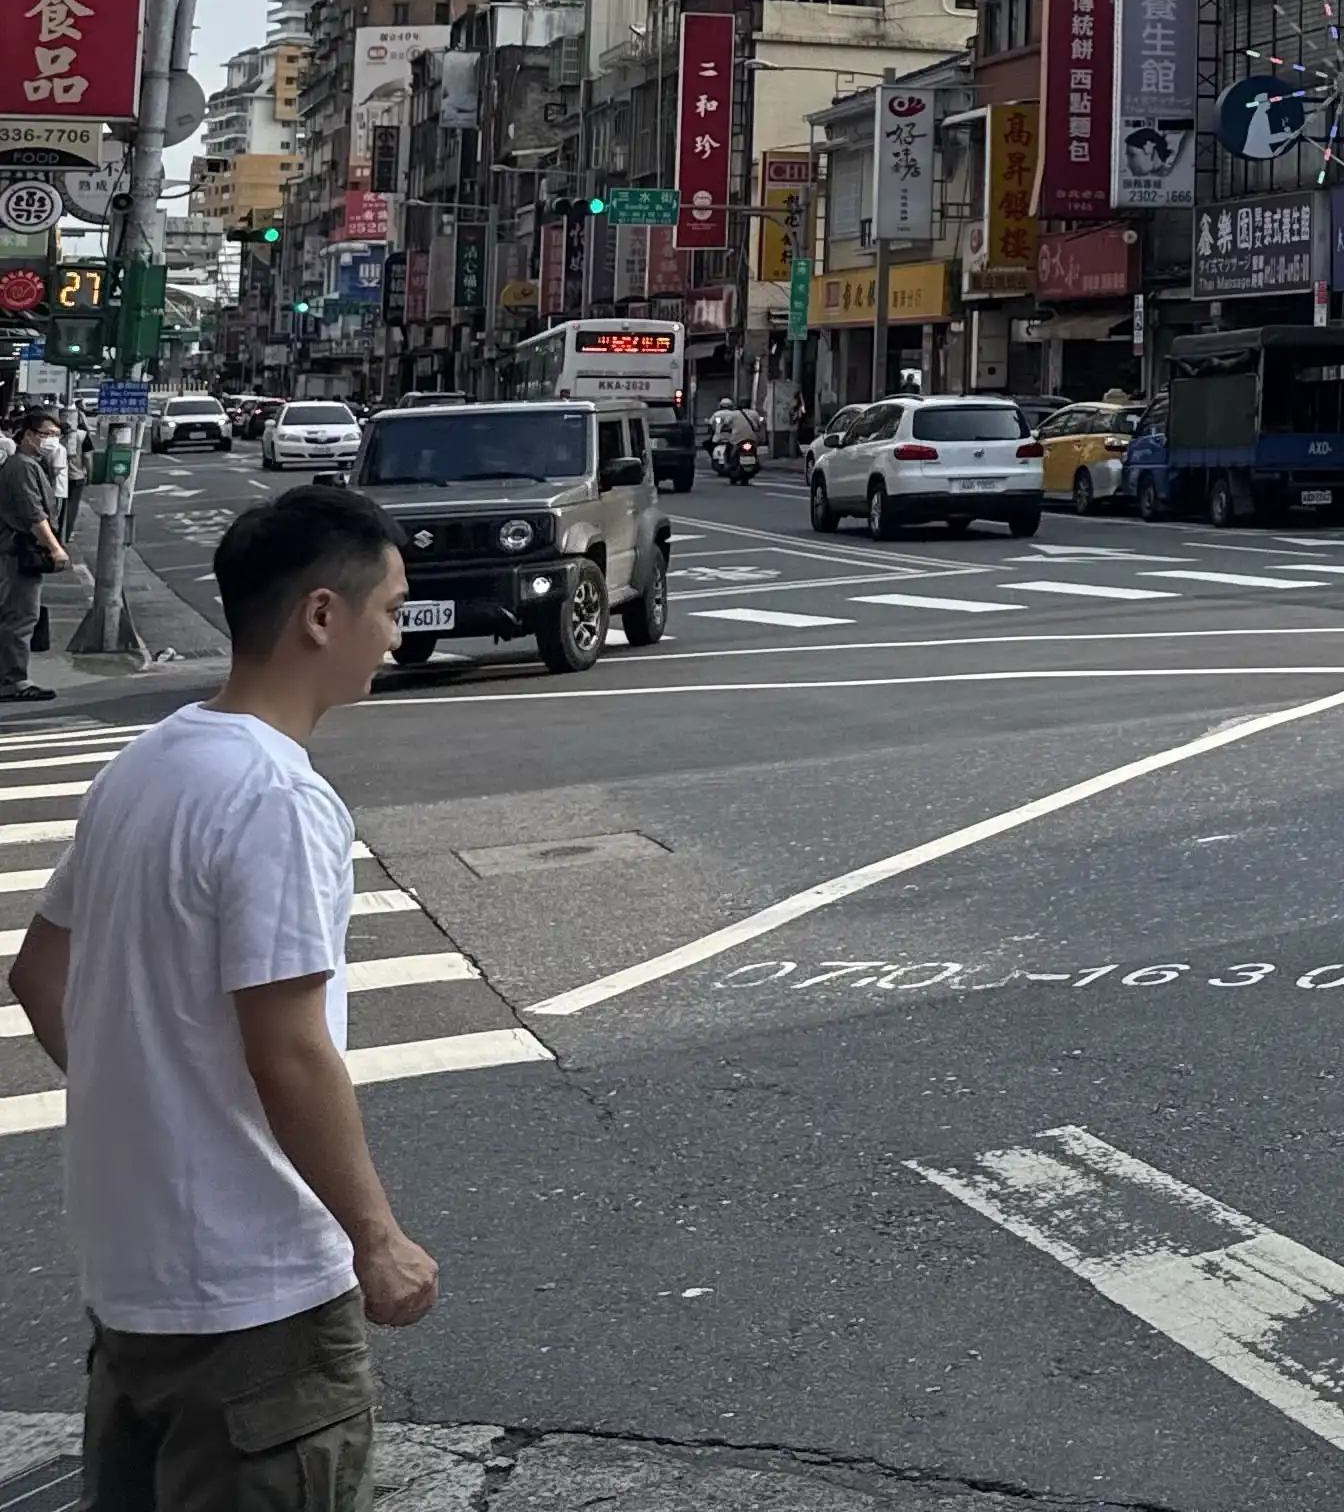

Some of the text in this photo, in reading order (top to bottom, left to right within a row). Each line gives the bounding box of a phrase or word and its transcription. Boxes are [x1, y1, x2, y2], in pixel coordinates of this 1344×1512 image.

[693, 61, 721, 160] 二和珍
[59, 271, 101, 307] 27
